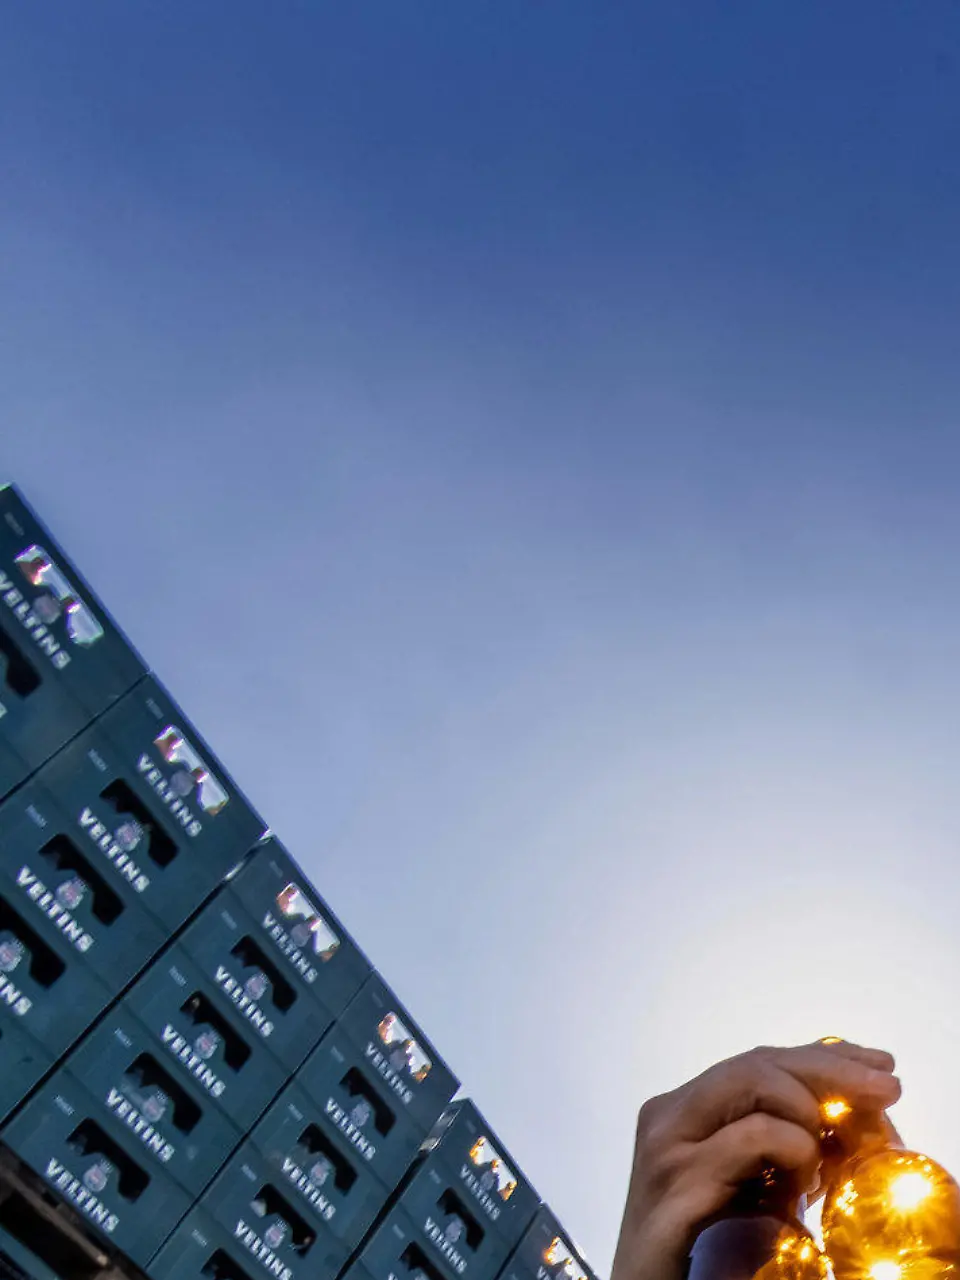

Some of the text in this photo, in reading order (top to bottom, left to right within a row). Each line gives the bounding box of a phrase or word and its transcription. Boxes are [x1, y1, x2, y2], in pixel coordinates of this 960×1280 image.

[138, 752, 203, 836] VELTINS
[78, 807, 150, 893] VELTINS
[16, 865, 95, 952] VELTINS
[213, 965, 274, 1037] VELTINS
[161, 1023, 226, 1098] VELTINS
[105, 1086, 175, 1162] VELTINS
[325, 1097, 376, 1161] VELTINS
[45, 1157, 120, 1231] VELTINS
[282, 1157, 336, 1220] VELTINS
